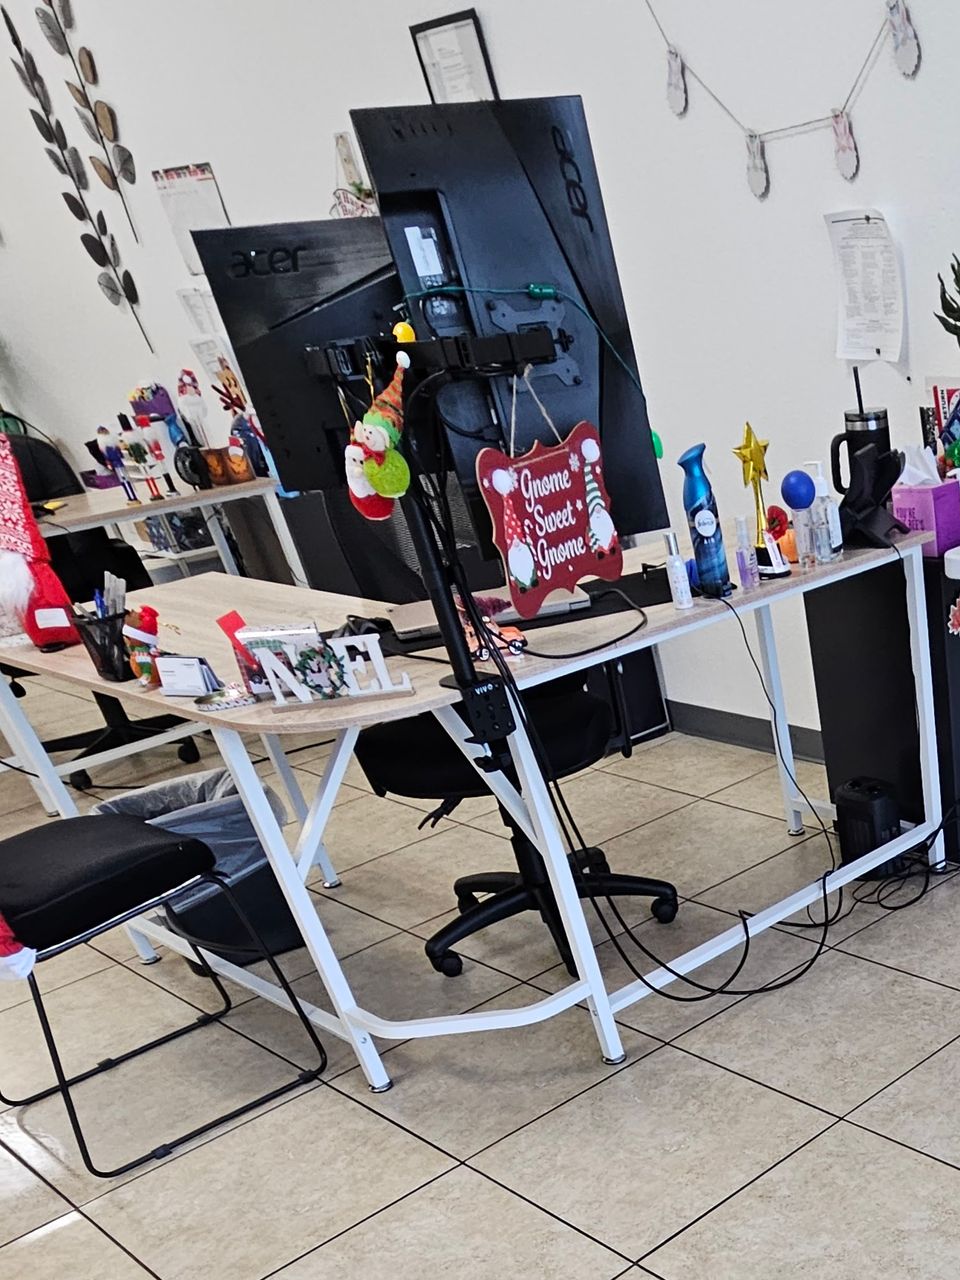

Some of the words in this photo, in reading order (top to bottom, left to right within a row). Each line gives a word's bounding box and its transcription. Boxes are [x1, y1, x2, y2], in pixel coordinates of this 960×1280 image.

[551, 124, 595, 234] acer
[229, 246, 308, 279] acer
[520, 468, 571, 512] Gnome
[533, 501, 577, 536] Sweet
[537, 536, 587, 580] Gnome
